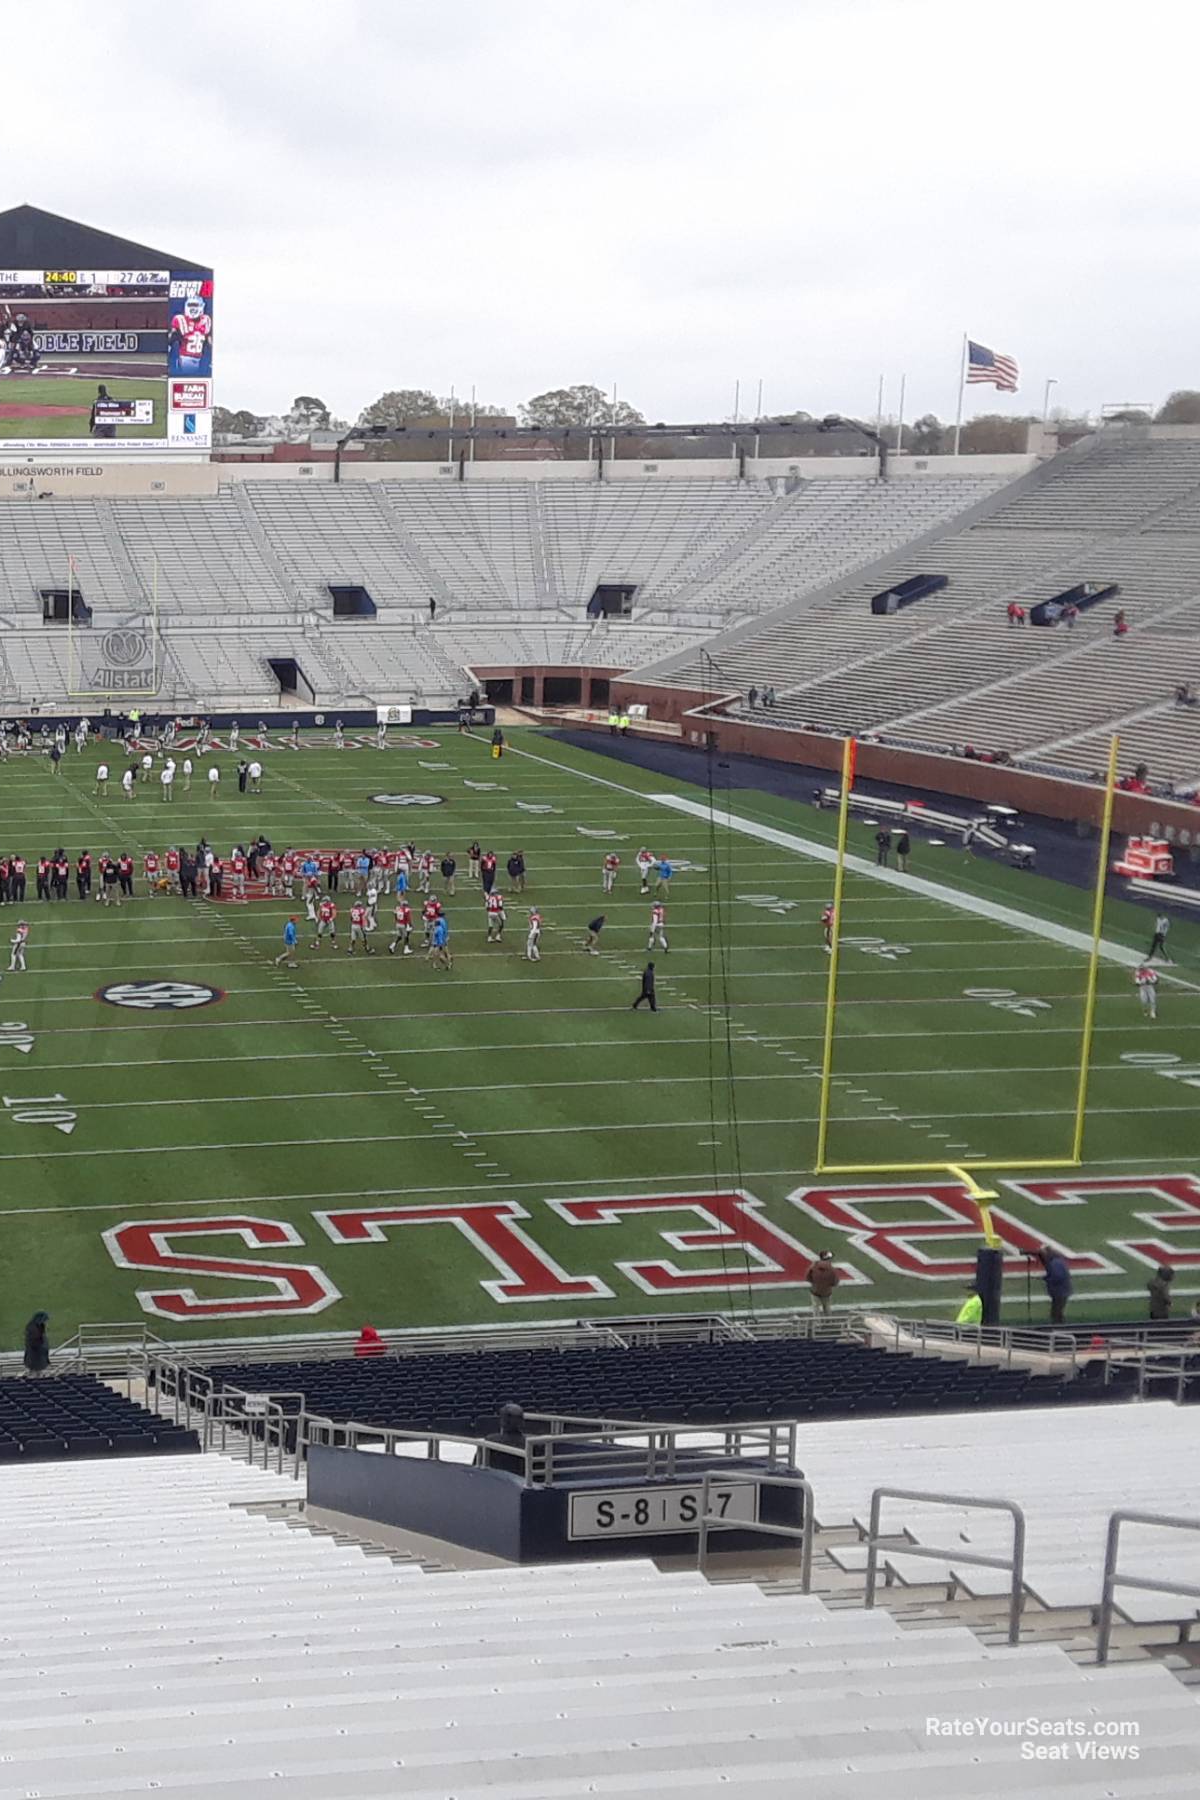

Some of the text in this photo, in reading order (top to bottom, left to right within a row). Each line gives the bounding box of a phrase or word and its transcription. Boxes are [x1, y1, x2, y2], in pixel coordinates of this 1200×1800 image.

[45, 272, 76, 283] 24:40
[32, 333, 139, 352] OBLE FIELD
[75, 467, 104, 476] FIELD
[2, 1093, 77, 1124] 10
[596, 1498, 650, 1528] S-8
